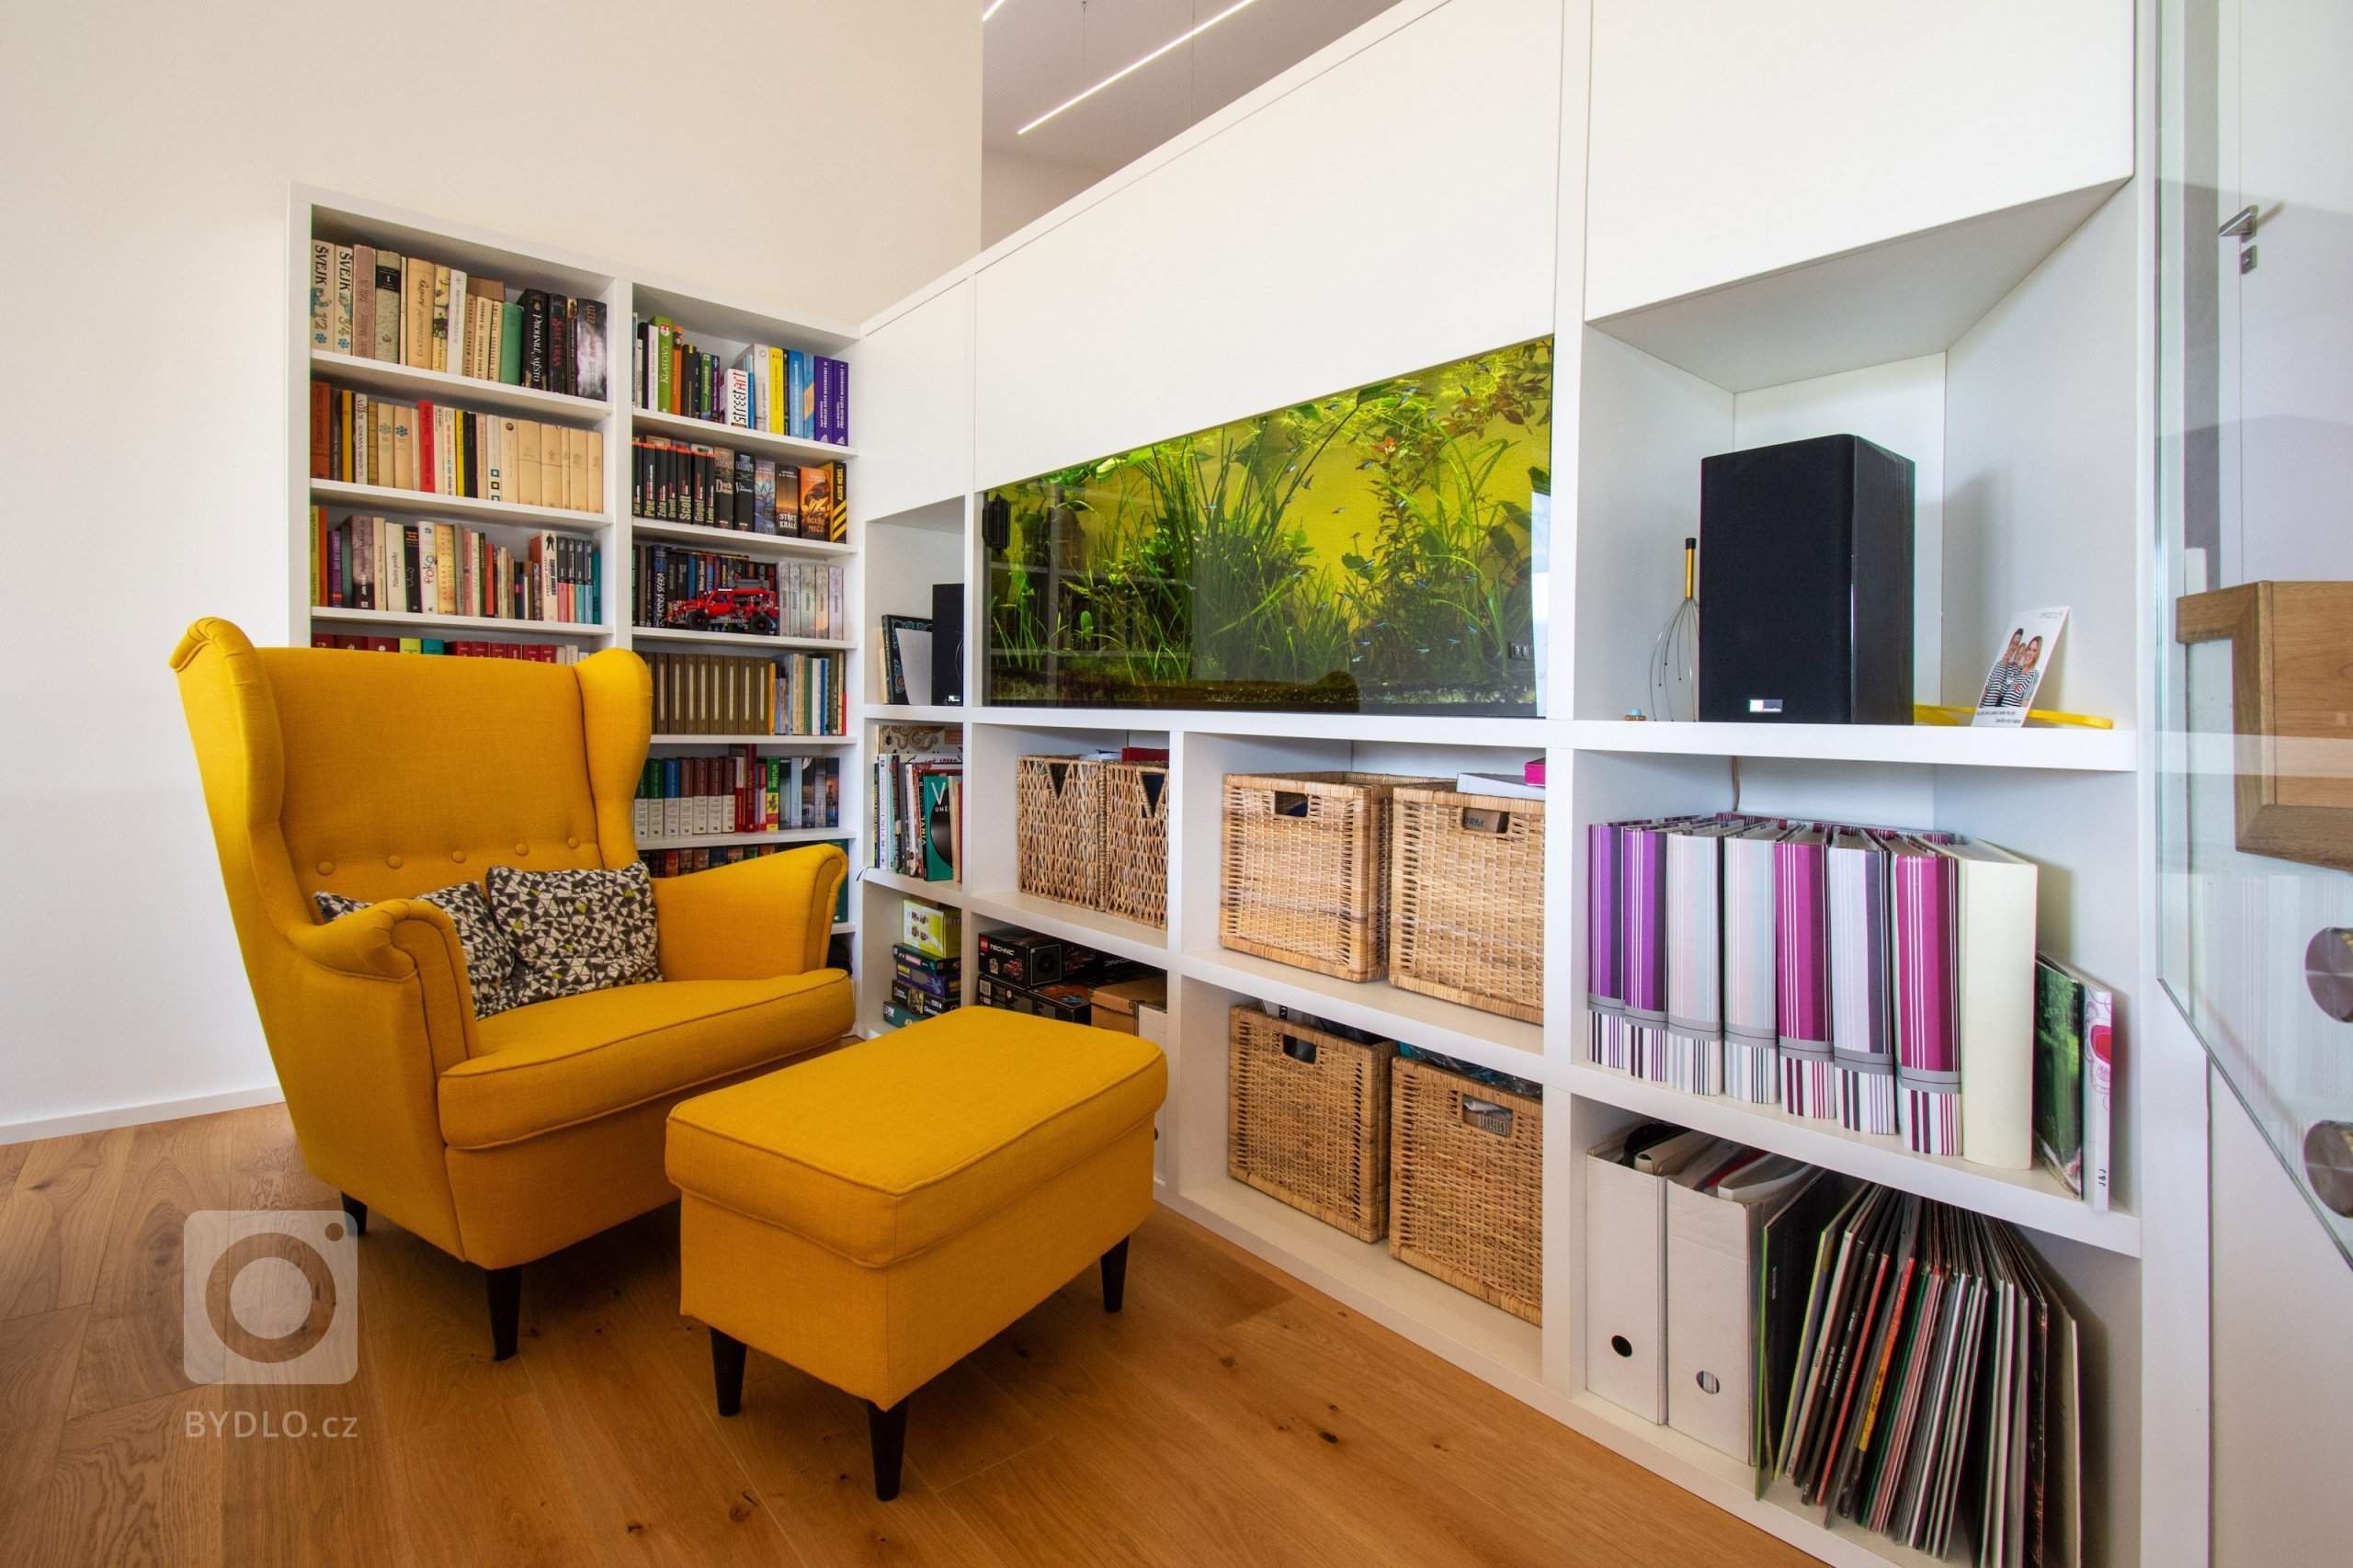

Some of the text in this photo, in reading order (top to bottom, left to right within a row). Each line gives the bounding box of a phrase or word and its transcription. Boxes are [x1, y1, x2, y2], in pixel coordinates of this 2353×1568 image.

[315, 244, 329, 286] ŠVEJK
[339, 251, 353, 293] ŠVEJK
[530, 357, 542, 382] MĚSTO
[660, 344, 669, 384] KLATOVY
[357, 399, 367, 420] LOLITA
[644, 500, 655, 517] Poe
[657, 501, 667, 518] Zola
[668, 499, 676, 518] Orwell
[679, 494, 691, 521] Scott
[694, 499, 705, 522] Gogol
[988, 943, 1015, 957] TECHNIC
